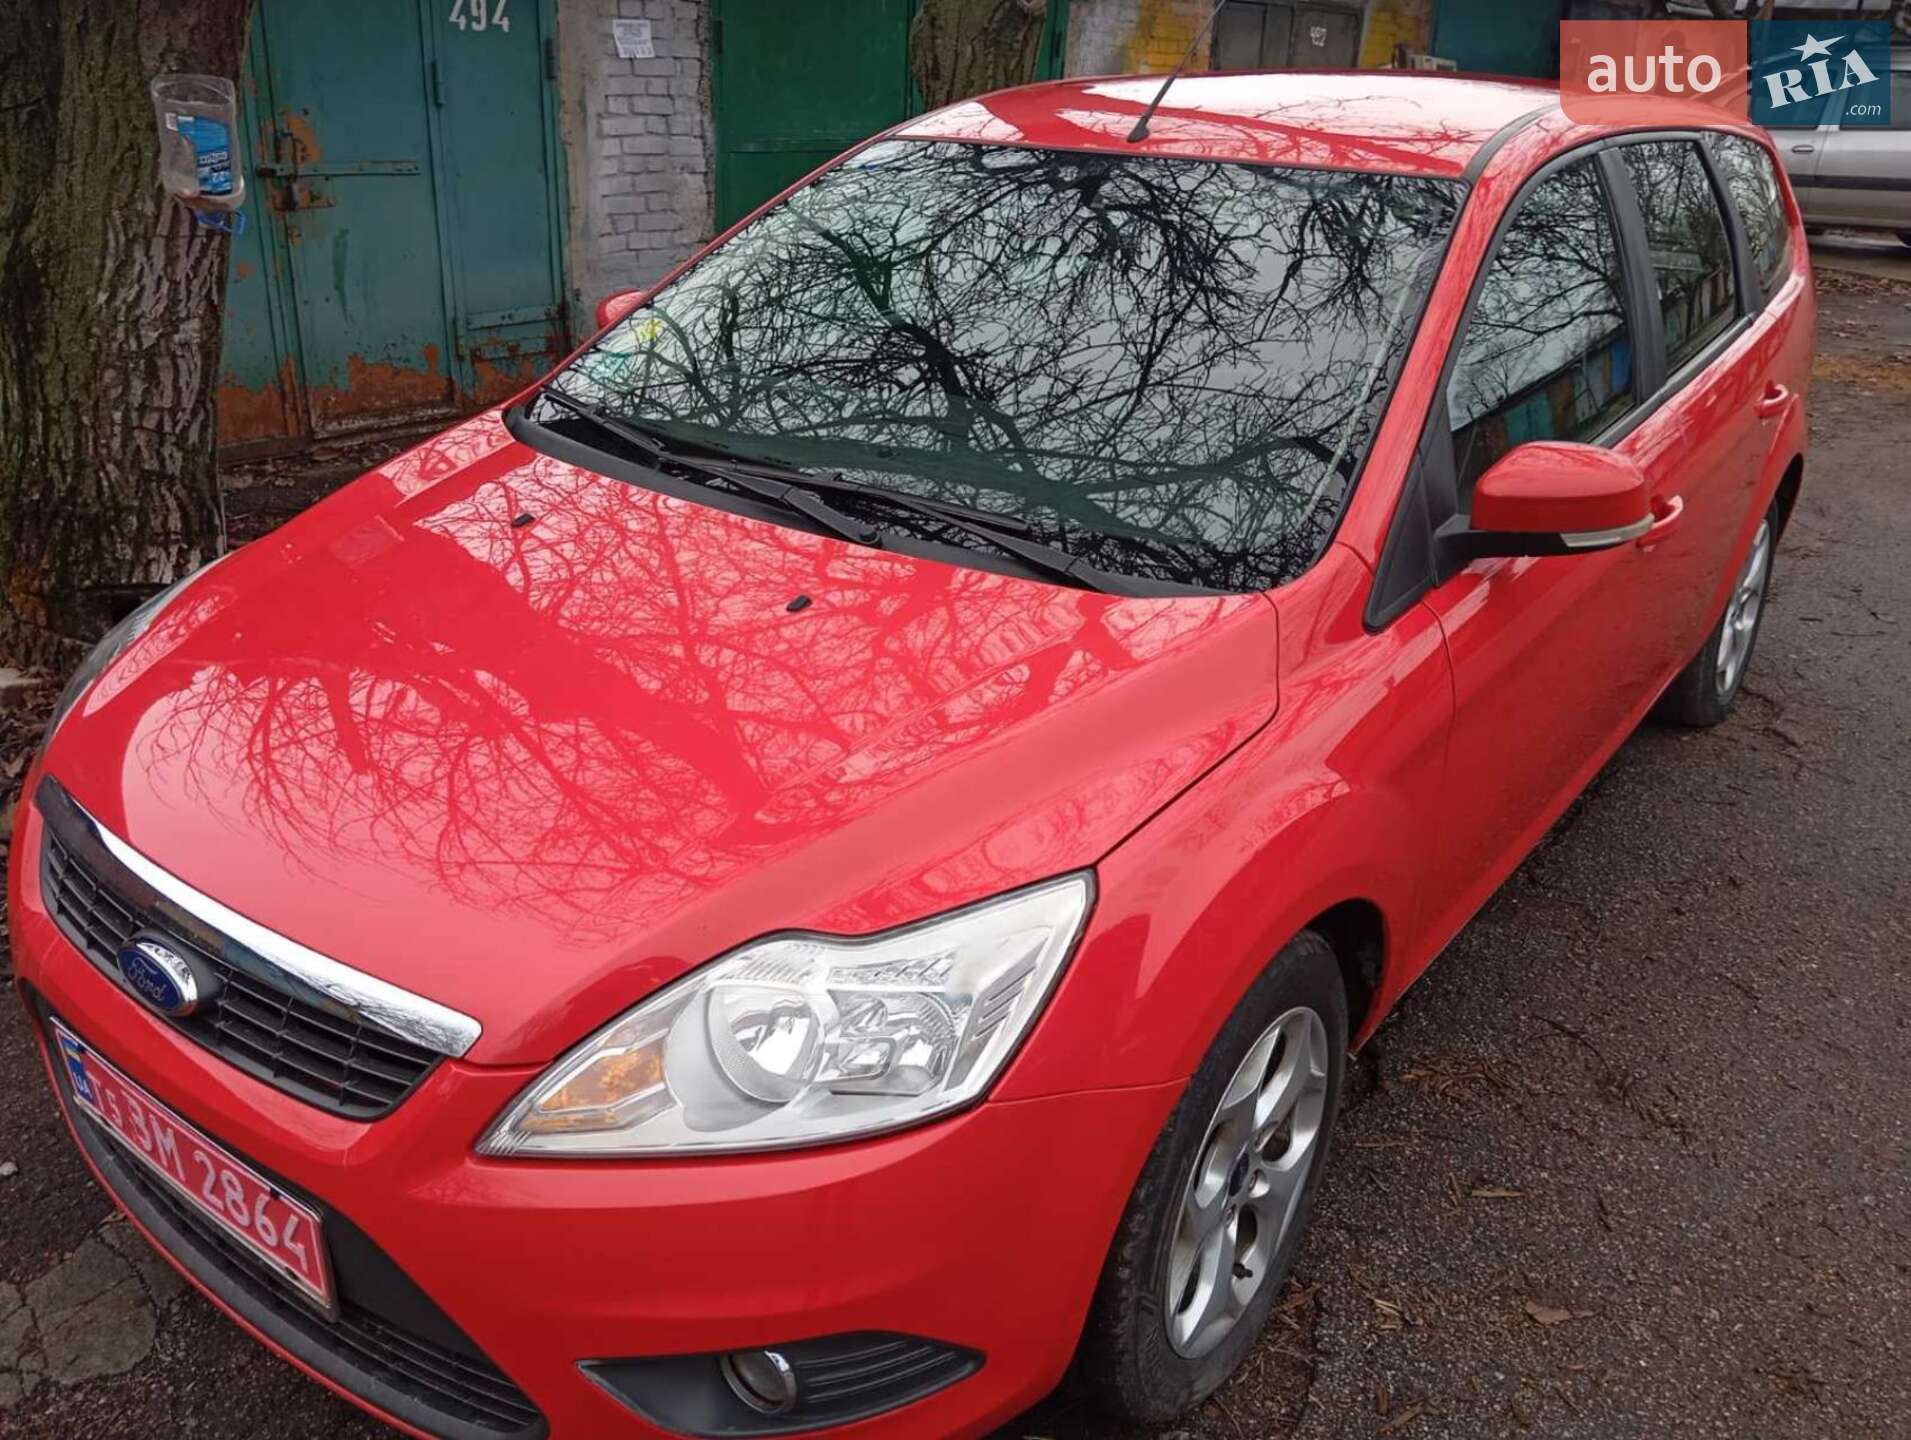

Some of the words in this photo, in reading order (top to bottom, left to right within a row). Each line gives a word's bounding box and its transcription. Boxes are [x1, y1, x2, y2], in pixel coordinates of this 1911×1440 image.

[448, 0, 510, 32] 494
[128, 956, 168, 1002] Ford
[73, 1071, 93, 1100] UA
[193, 1150, 310, 1274] 2864
